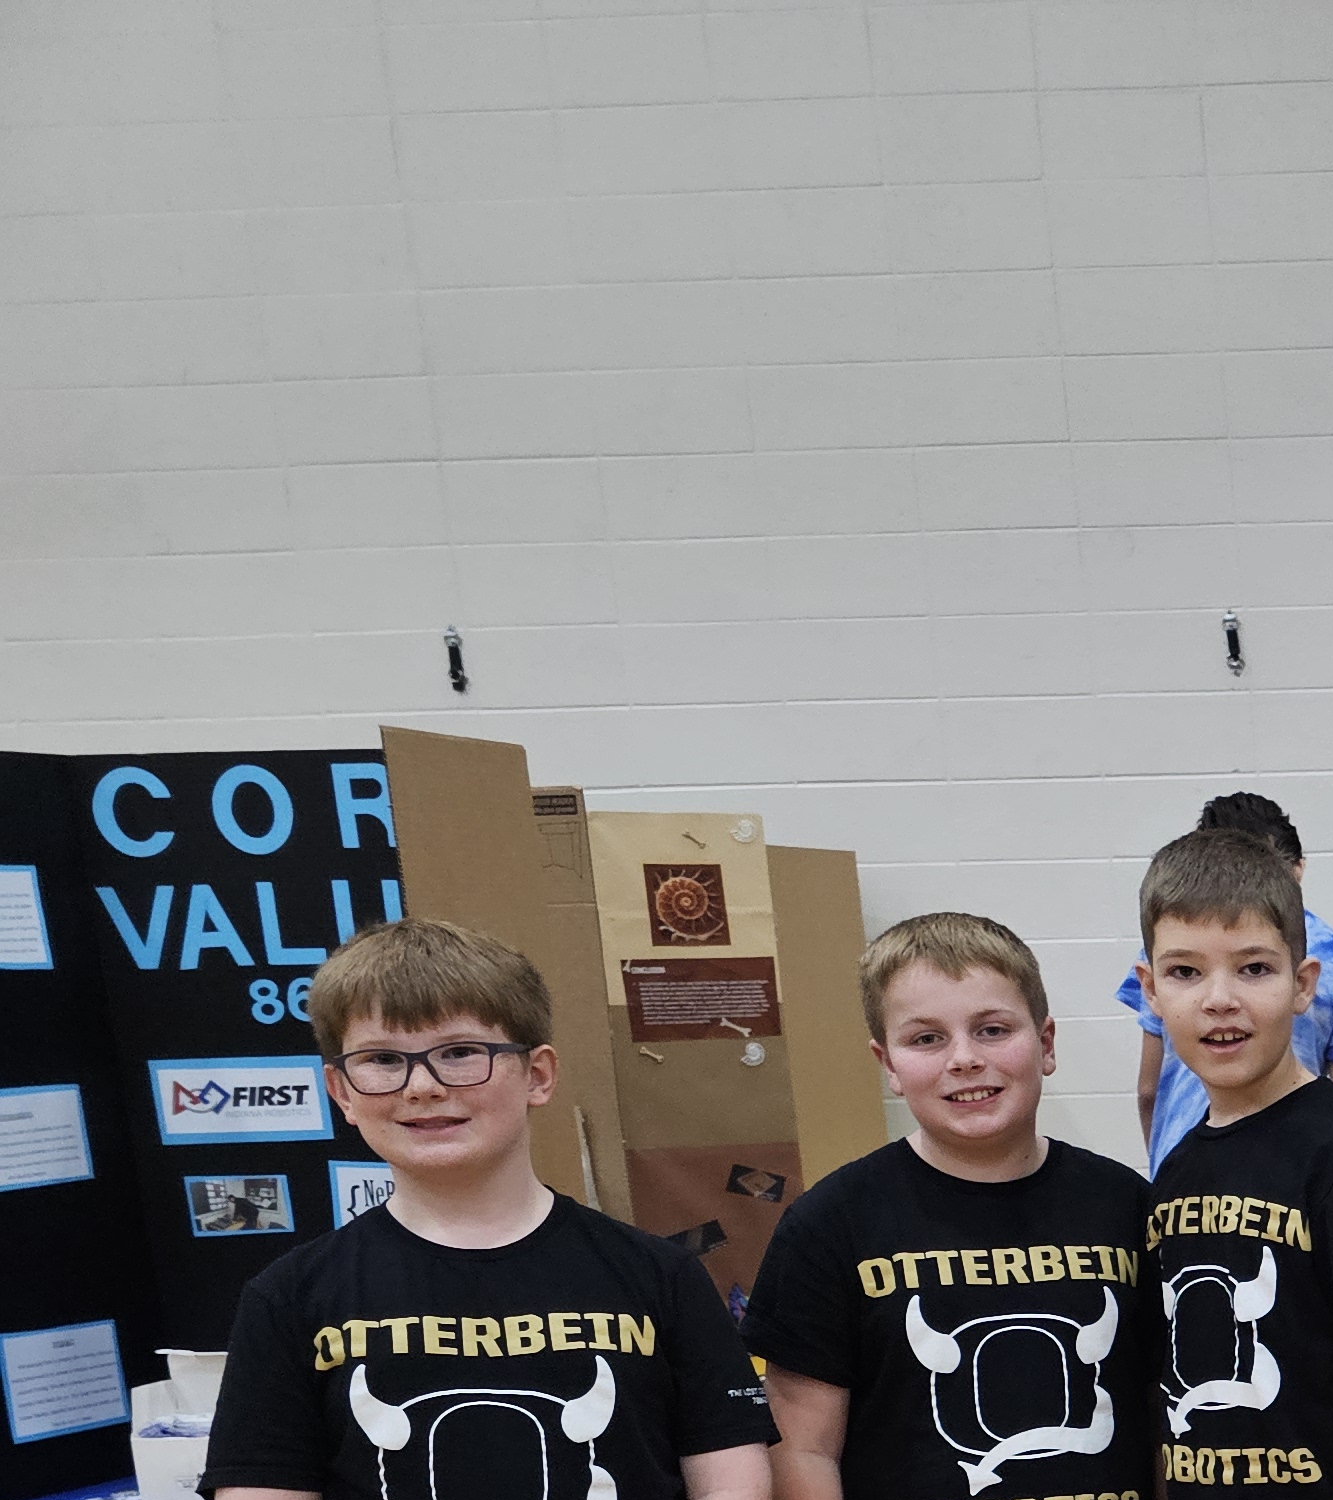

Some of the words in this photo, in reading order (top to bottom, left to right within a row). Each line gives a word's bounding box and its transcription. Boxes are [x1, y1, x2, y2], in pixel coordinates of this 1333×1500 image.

[92, 763, 397, 858] COR
[232, 1085, 310, 1107] FIRST
[857, 1243, 1139, 1298] OTTERBEIN
[315, 1311, 656, 1371] OTTERBEIN
